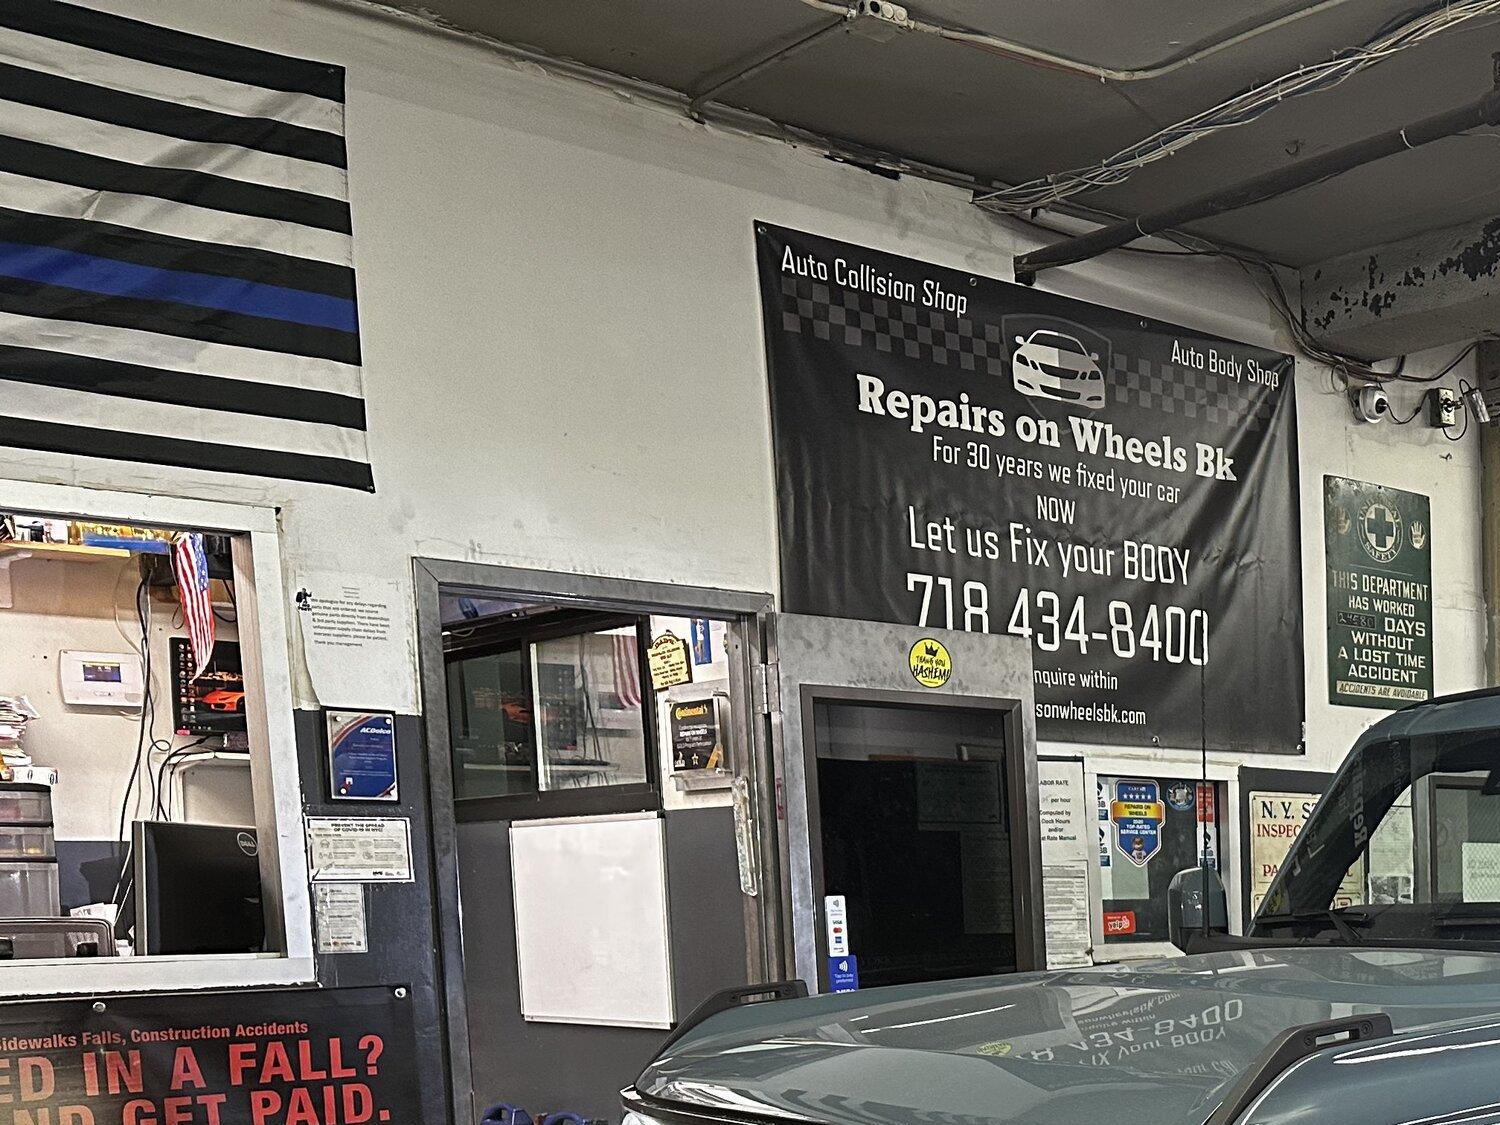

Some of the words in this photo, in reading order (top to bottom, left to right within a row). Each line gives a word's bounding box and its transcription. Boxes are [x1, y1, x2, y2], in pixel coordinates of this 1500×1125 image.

[781, 245, 829, 281] Auto
[834, 258, 915, 303] Collision
[922, 280, 967, 318] Shop
[1171, 340, 1204, 370] Auto
[1209, 349, 1242, 383] Body
[1247, 359, 1280, 391] Shop
[856, 373, 1006, 437] Repairs
[1015, 414, 1061, 448] on
[1068, 415, 1187, 472] Wheels
[1195, 442, 1237, 481] Bk
[933, 435, 961, 465] For
[966, 441, 990, 470] 30
[996, 453, 1043, 479] years
[1048, 463, 1071, 485] we
[1076, 462, 1115, 493] fixed
[1120, 477, 1152, 499] your
[1157, 484, 1181, 504] car
[1037, 495, 1076, 525] NOW
[908, 505, 957, 554] Let
[966, 528, 999, 560] us
[1009, 522, 1050, 568] Fix
[1057, 541, 1115, 578] your
[1123, 540, 1190, 586] BODY
[1365, 541, 1397, 561] SAFETY
[1332, 570, 1358, 590] THIS
[1362, 574, 1429, 602] DEPARTMENT
[1348, 595, 1369, 611] HAS
[1373, 599, 1415, 617] WORKED
[907, 573, 990, 634] 718
[1008, 588, 1209, 666] 434-8400
[1384, 617, 1426, 637] DAYS
[1351, 630, 1414, 651] WITHOUT
[916, 655, 934, 665] THANK
[1338, 646, 1348, 660] A
[1354, 647, 1390, 664] LOST
[1395, 652, 1426, 669] TIME
[1080, 670, 1118, 690] within
[1348, 663, 1418, 684] ACCIDENT
[1339, 683, 1377, 695] ACCIDENTS
[1377, 687, 1391, 697] ARE
[1392, 688, 1426, 700] AVOIDABLE
[1035, 700, 1147, 725] sonwheelsbk.com
[360, 727, 391, 735] ACDelco
[1261, 801, 1277, 819] N.
[1280, 802, 1295, 819] Y.
[1302, 802, 1317, 820] S
[1108, 920, 1124, 931] yelp
[82, 1029, 127, 1047] Falls,
[131, 1023, 231, 1044] Construction
[235, 1020, 308, 1038] Accidents
[83, 1048, 144, 1096] IN
[170, 1045, 206, 1091] A
[229, 1034, 385, 1087] FALL?
